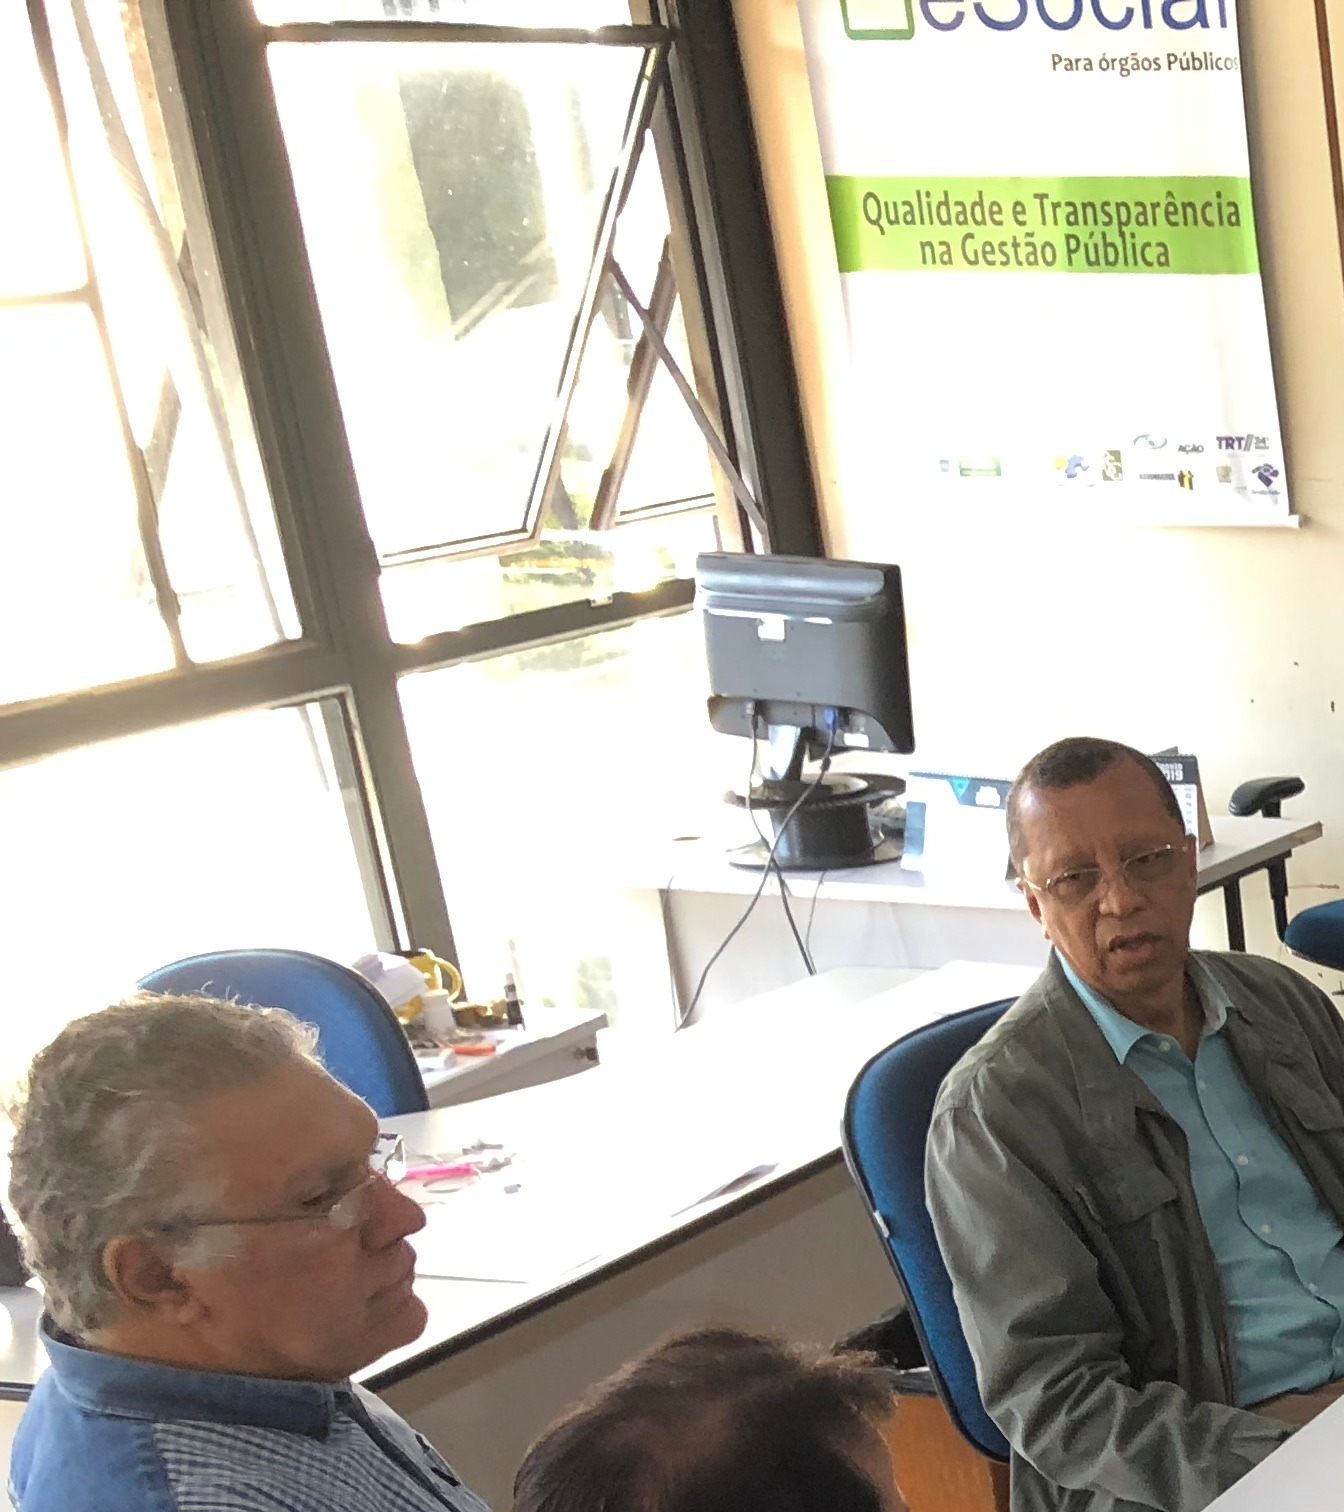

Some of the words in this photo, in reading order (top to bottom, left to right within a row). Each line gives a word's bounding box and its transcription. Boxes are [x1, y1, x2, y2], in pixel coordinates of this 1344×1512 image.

[1051, 53, 1094, 71] Para
[1099, 52, 1162, 77] órgãos
[1166, 51, 1239, 71] Públicos
[862, 190, 1004, 236] Qualidade
[1012, 200, 1028, 226] e
[1032, 190, 1242, 234] Transparência
[919, 239, 954, 267] na
[960, 231, 1058, 267] Gestão
[1064, 231, 1171, 268] Pública
